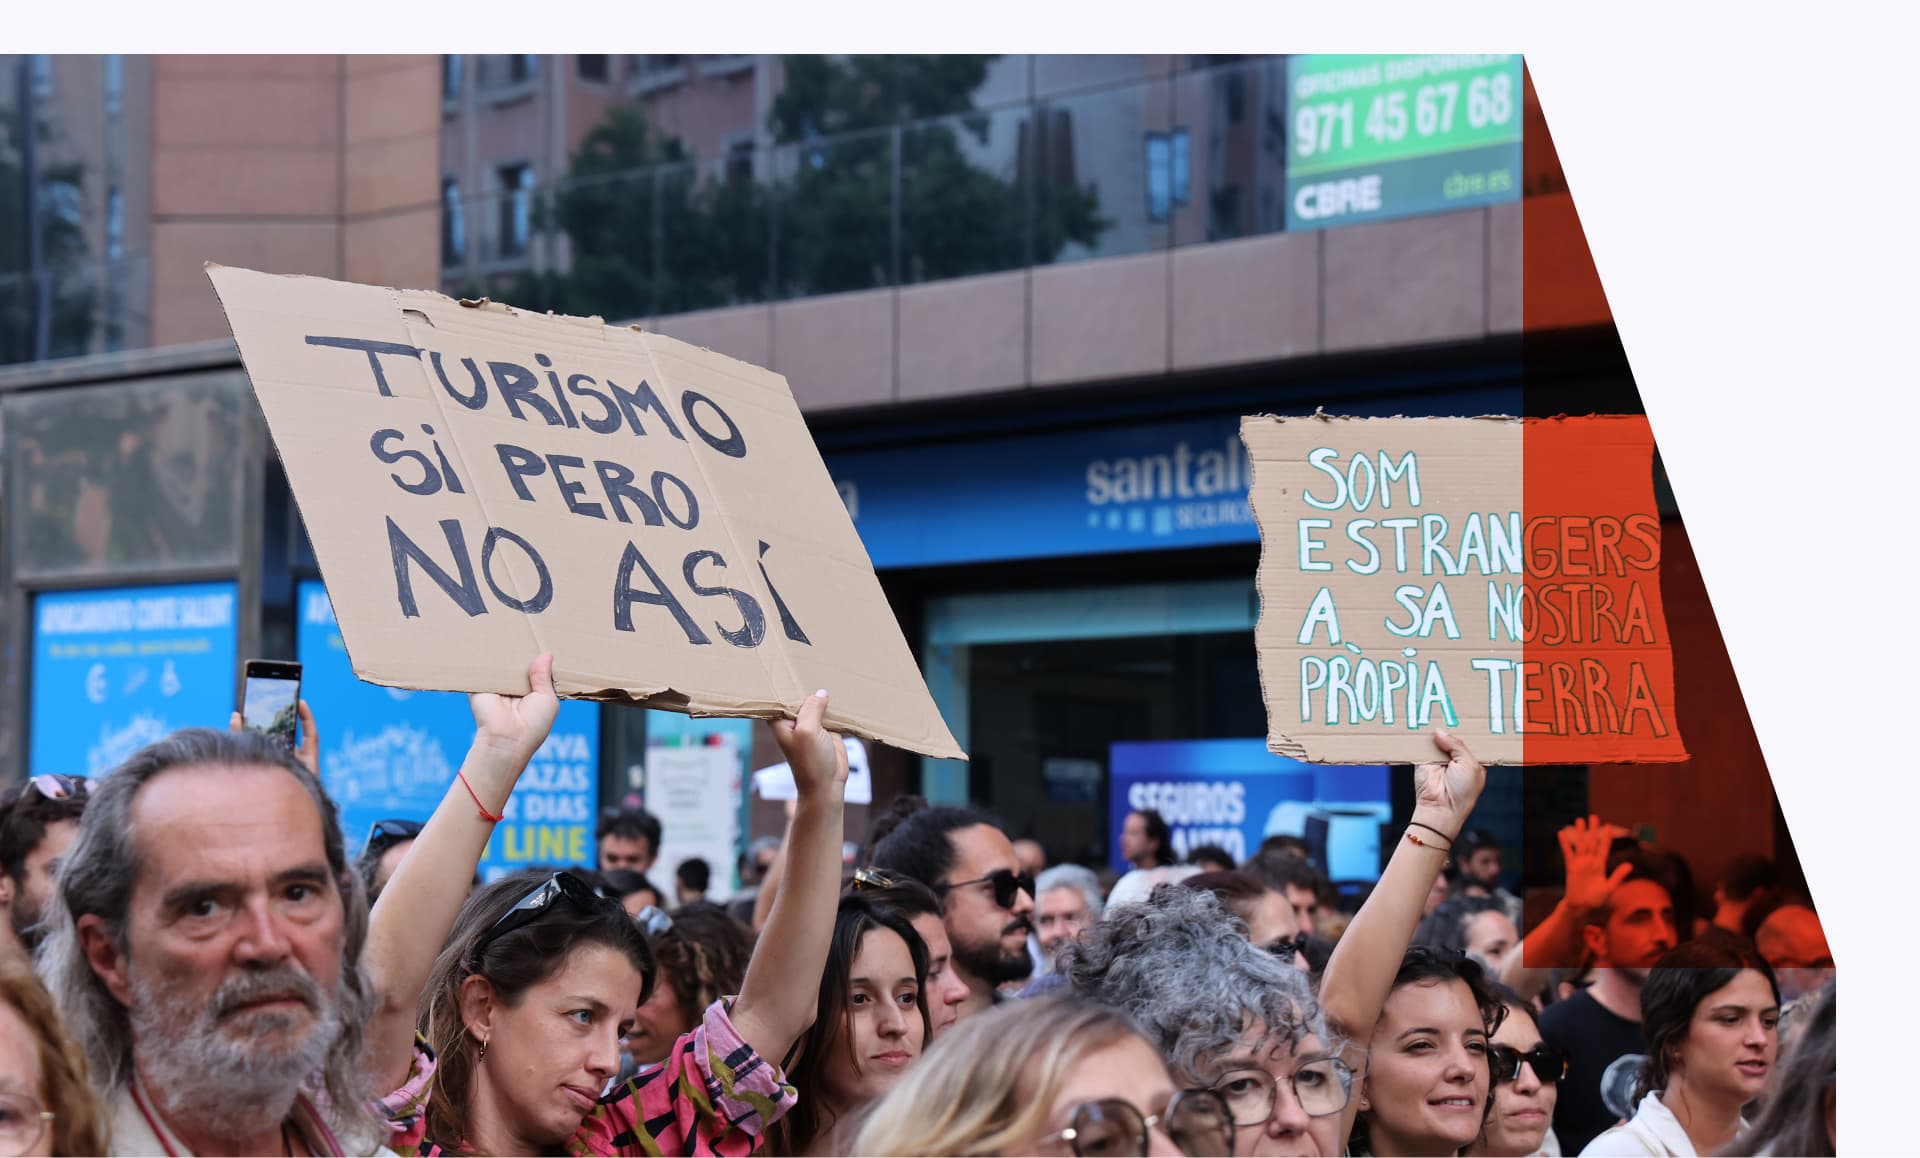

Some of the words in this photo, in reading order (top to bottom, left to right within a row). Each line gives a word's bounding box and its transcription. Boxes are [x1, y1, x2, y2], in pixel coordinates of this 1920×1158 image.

[1296, 103, 1355, 156] 971
[1364, 91, 1407, 144] 45
[1415, 82, 1460, 136] 67
[1467, 74, 1512, 128] 68
[1295, 174, 1382, 219] CBRE
[495, 444, 699, 530] PERO
[1303, 447, 1421, 511] SOM
[386, 515, 554, 618] NO
[1299, 512, 1661, 579] ESTRANGERS
[1297, 587, 1341, 645] A
[1384, 582, 1460, 639] SA
[1487, 580, 1656, 645] NOSTRA
[1471, 658, 1668, 737] TERRA
[518, 764, 590, 791] AZAS
[524, 793, 590, 821] DIAS
[1127, 781, 1246, 825] SEGUROS
[504, 825, 587, 861] LINE
